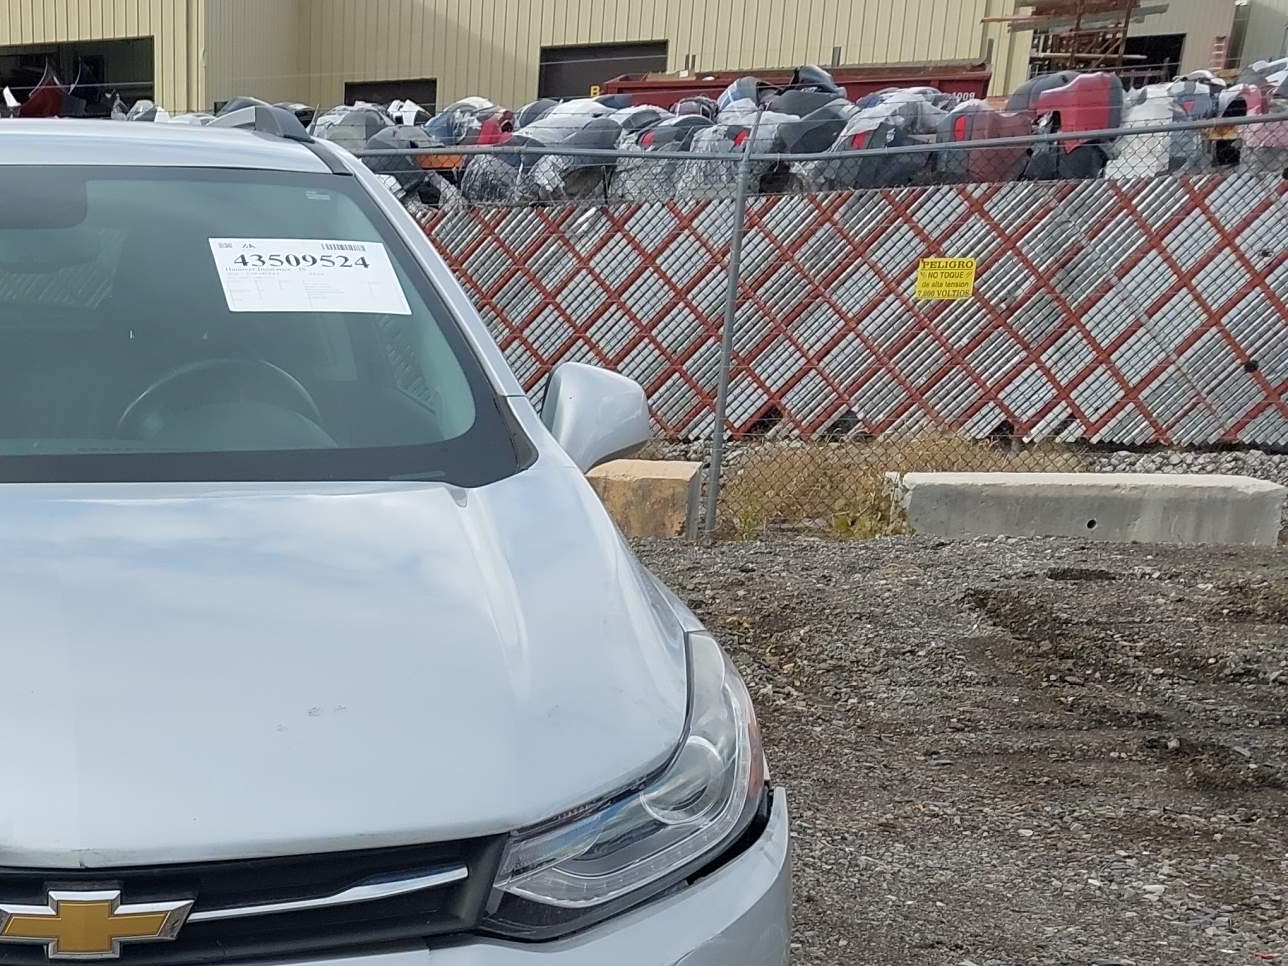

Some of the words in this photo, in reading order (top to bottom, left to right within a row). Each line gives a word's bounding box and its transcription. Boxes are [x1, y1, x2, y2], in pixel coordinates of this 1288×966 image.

[233, 253, 370, 269] 43509524
[922, 260, 974, 268] PELIGRO
[928, 271, 939, 279] NO
[940, 271, 964, 279] TOQUE
